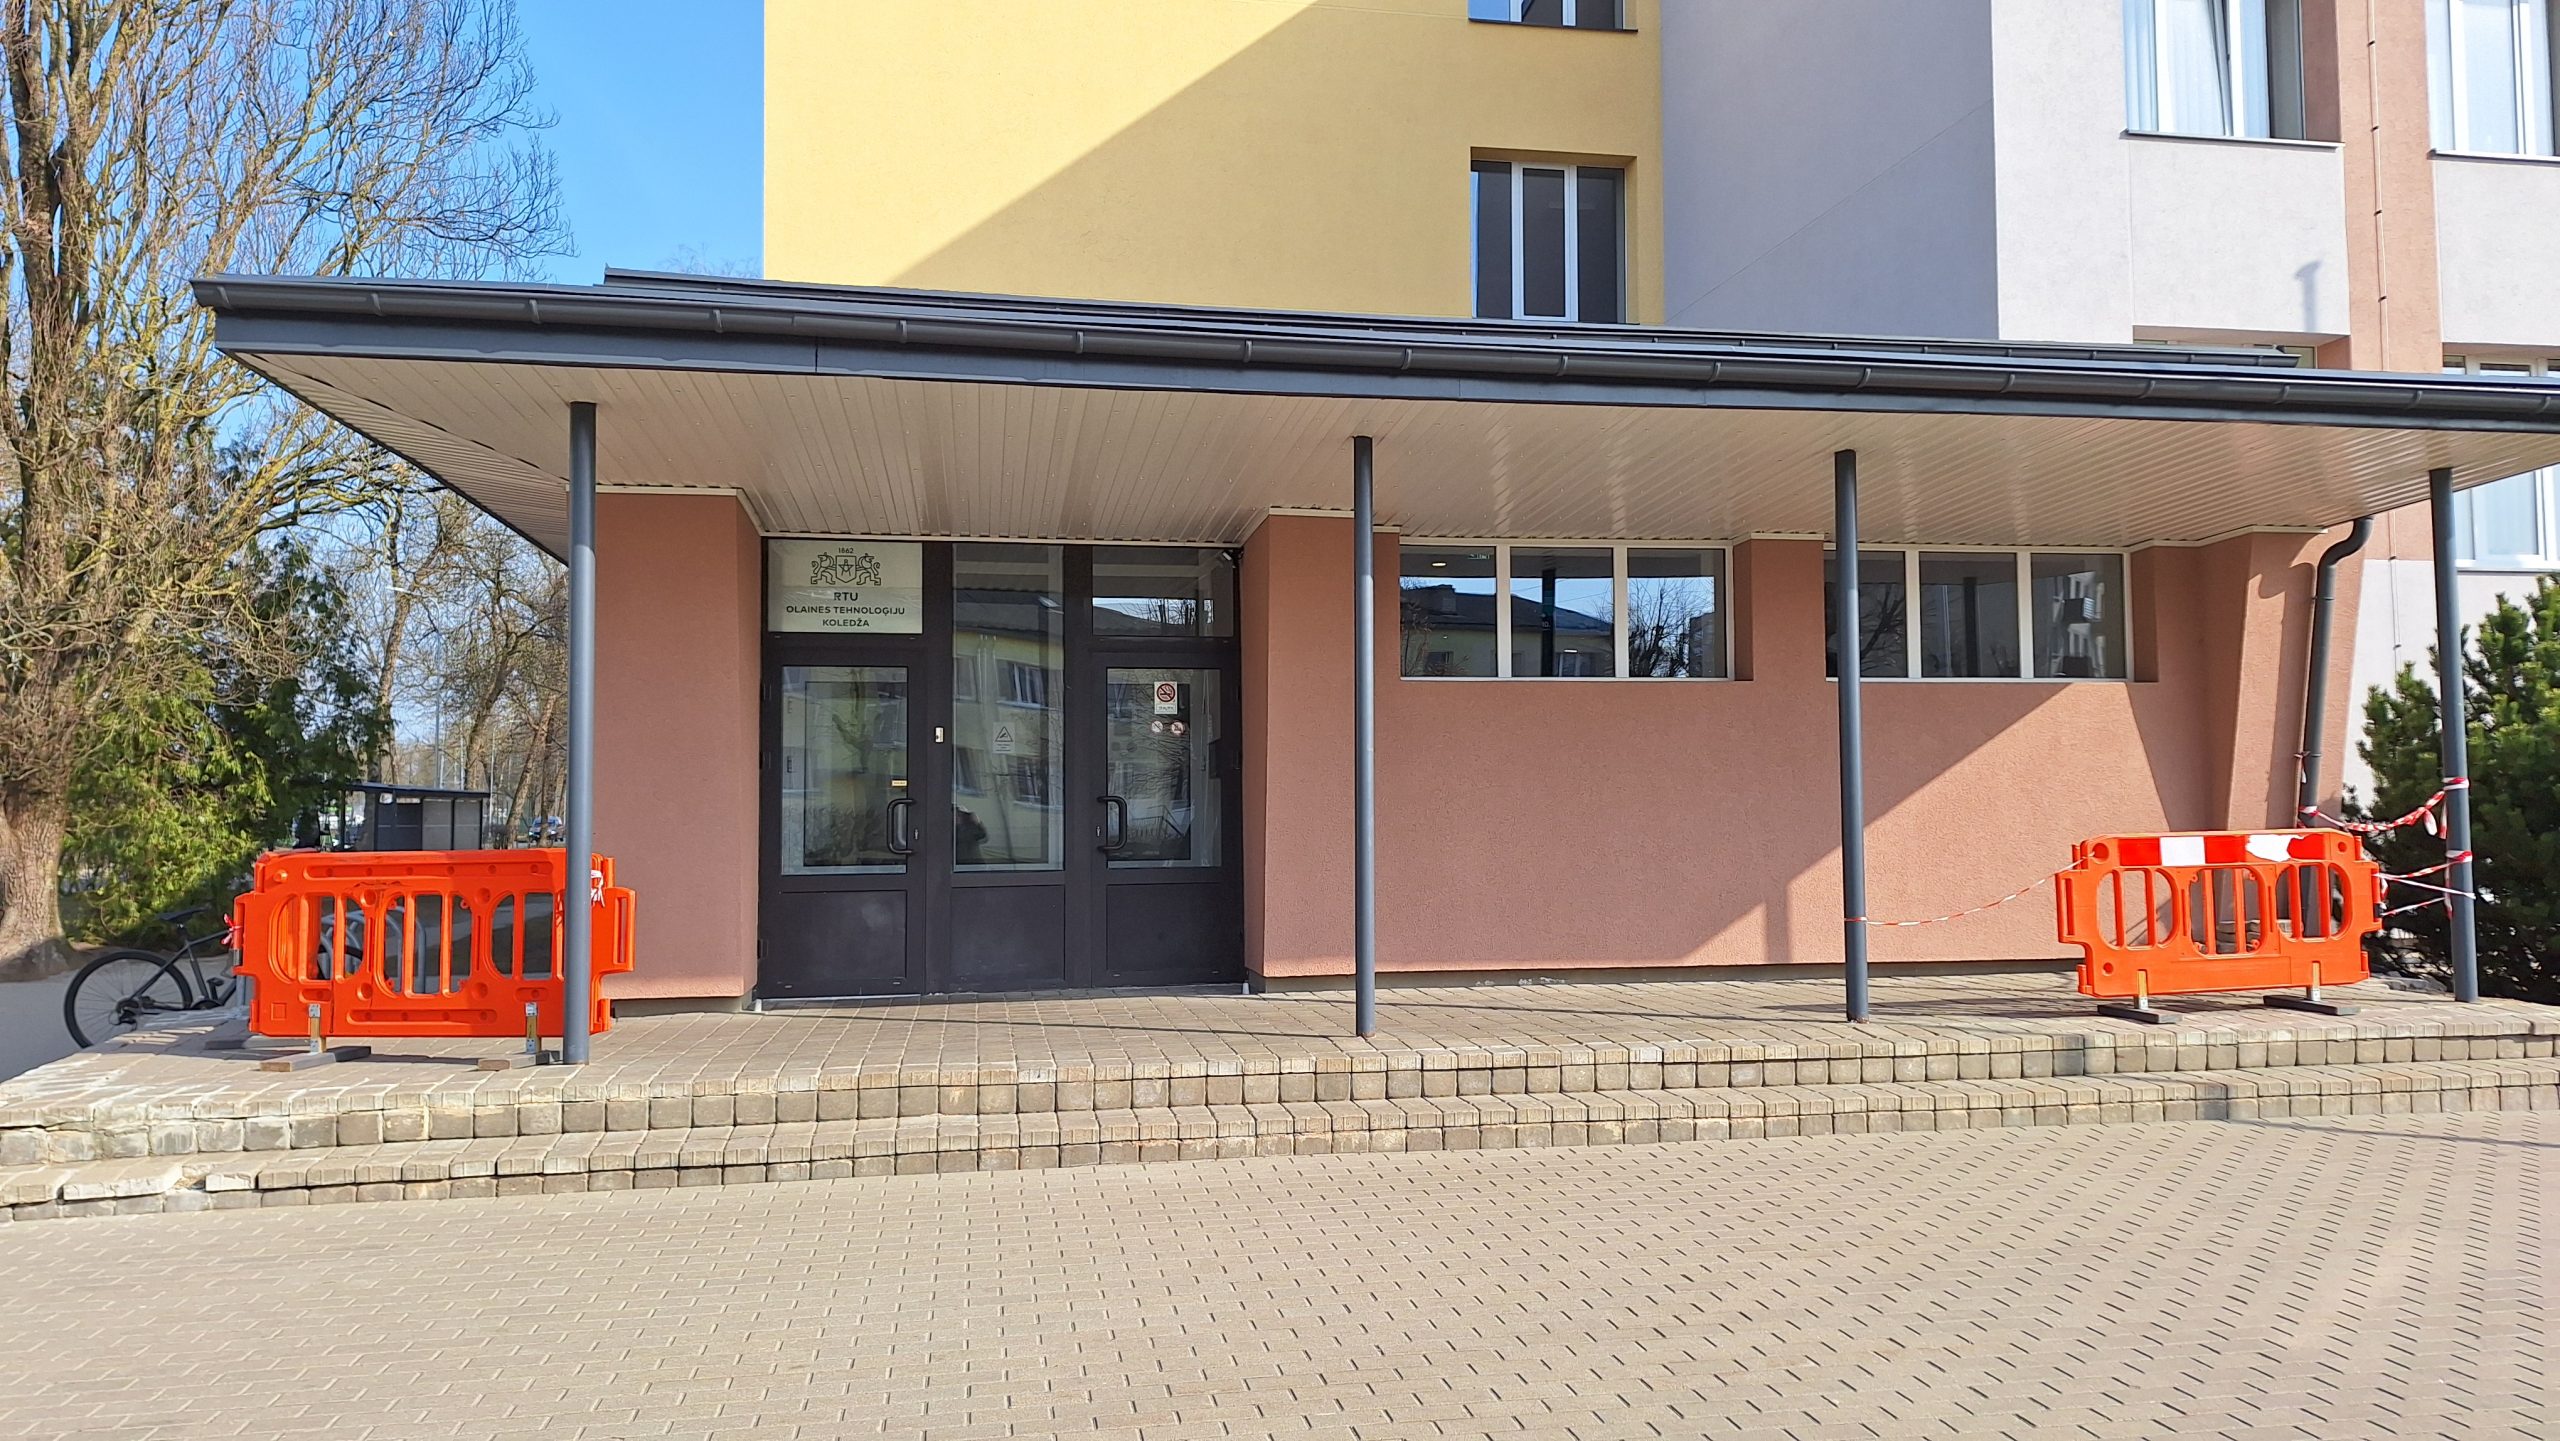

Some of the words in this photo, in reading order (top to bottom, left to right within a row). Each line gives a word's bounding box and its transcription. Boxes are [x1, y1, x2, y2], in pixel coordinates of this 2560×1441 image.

[833, 592, 859, 601] RTU
[786, 605, 831, 614] OLAINES
[833, 606, 905, 616] TEHNOLOĢIJU
[822, 618, 870, 627] KOLEDŽA
